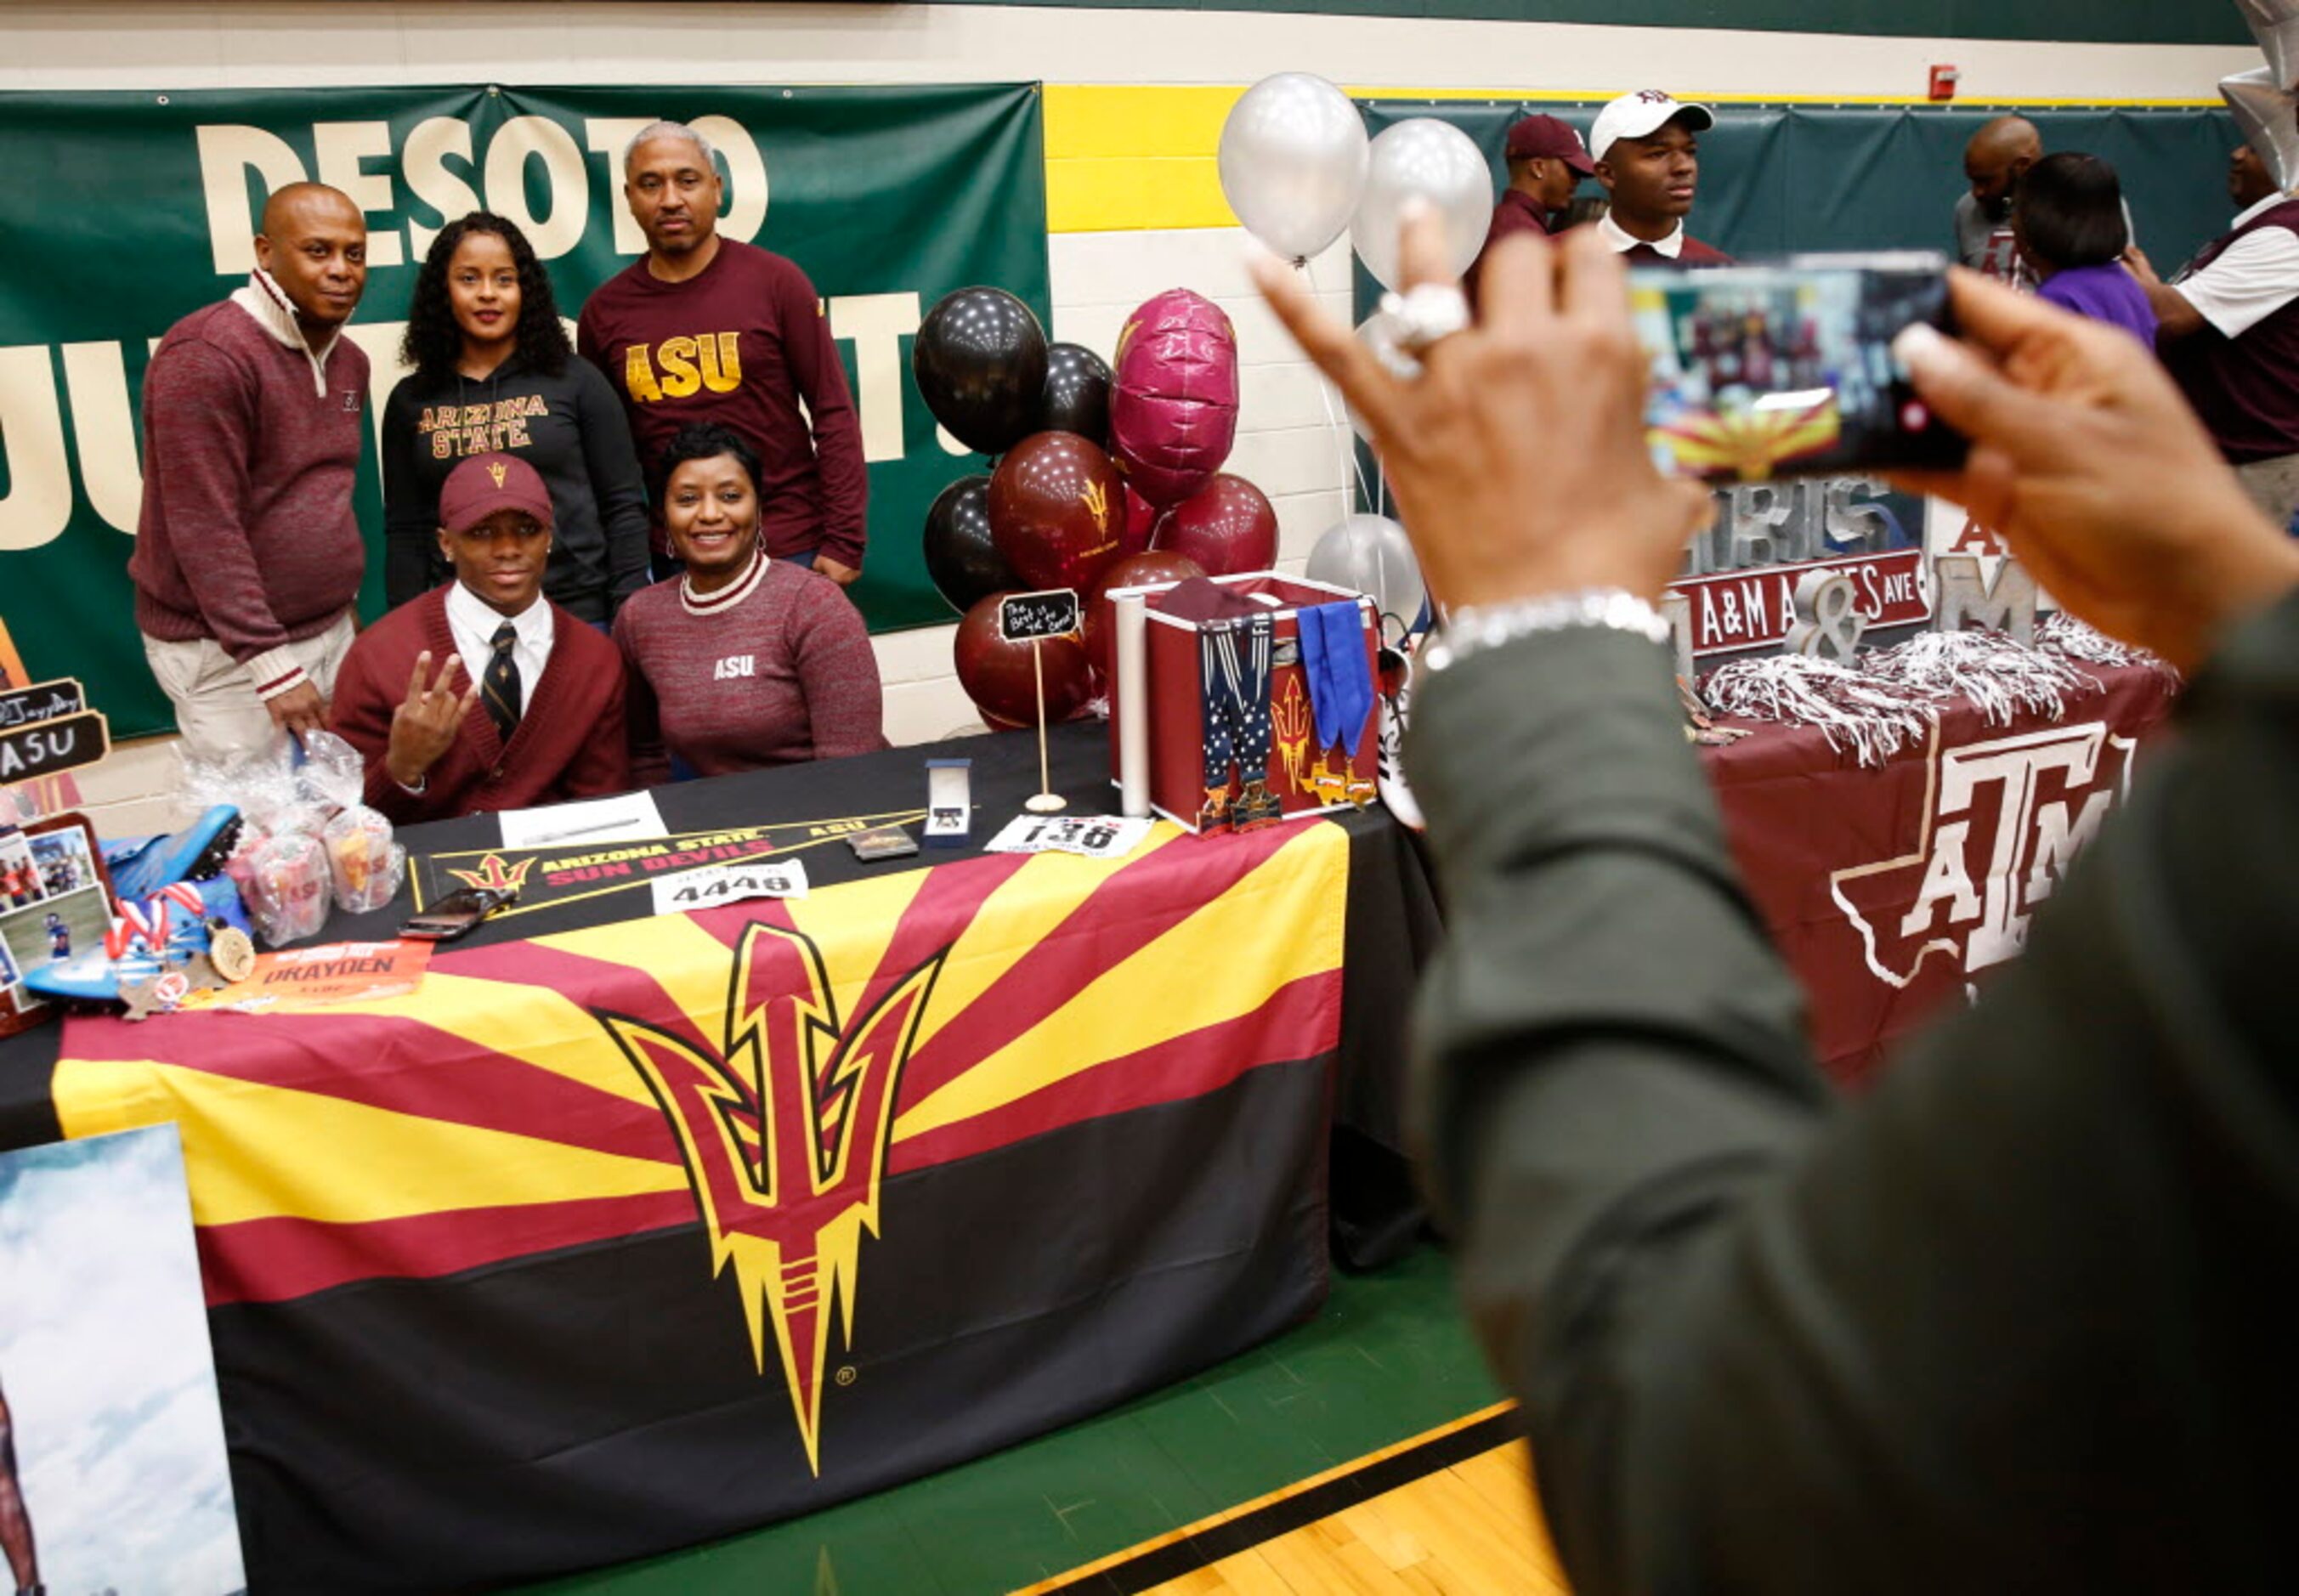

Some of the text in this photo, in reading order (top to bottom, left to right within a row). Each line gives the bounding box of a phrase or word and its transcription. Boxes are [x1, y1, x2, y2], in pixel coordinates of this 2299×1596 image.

[626, 331, 742, 403] ASU
[419, 394, 549, 434] ARIZONA
[433, 417, 533, 459] STATE
[1702, 580, 1769, 645] A&M
[1884, 572, 1916, 604] AVE
[714, 654, 755, 681] ASU
[2, 727, 76, 778] ASU
[541, 820, 867, 873] ARIZONA STATE ASU
[546, 839, 776, 886] SUN DEVILS
